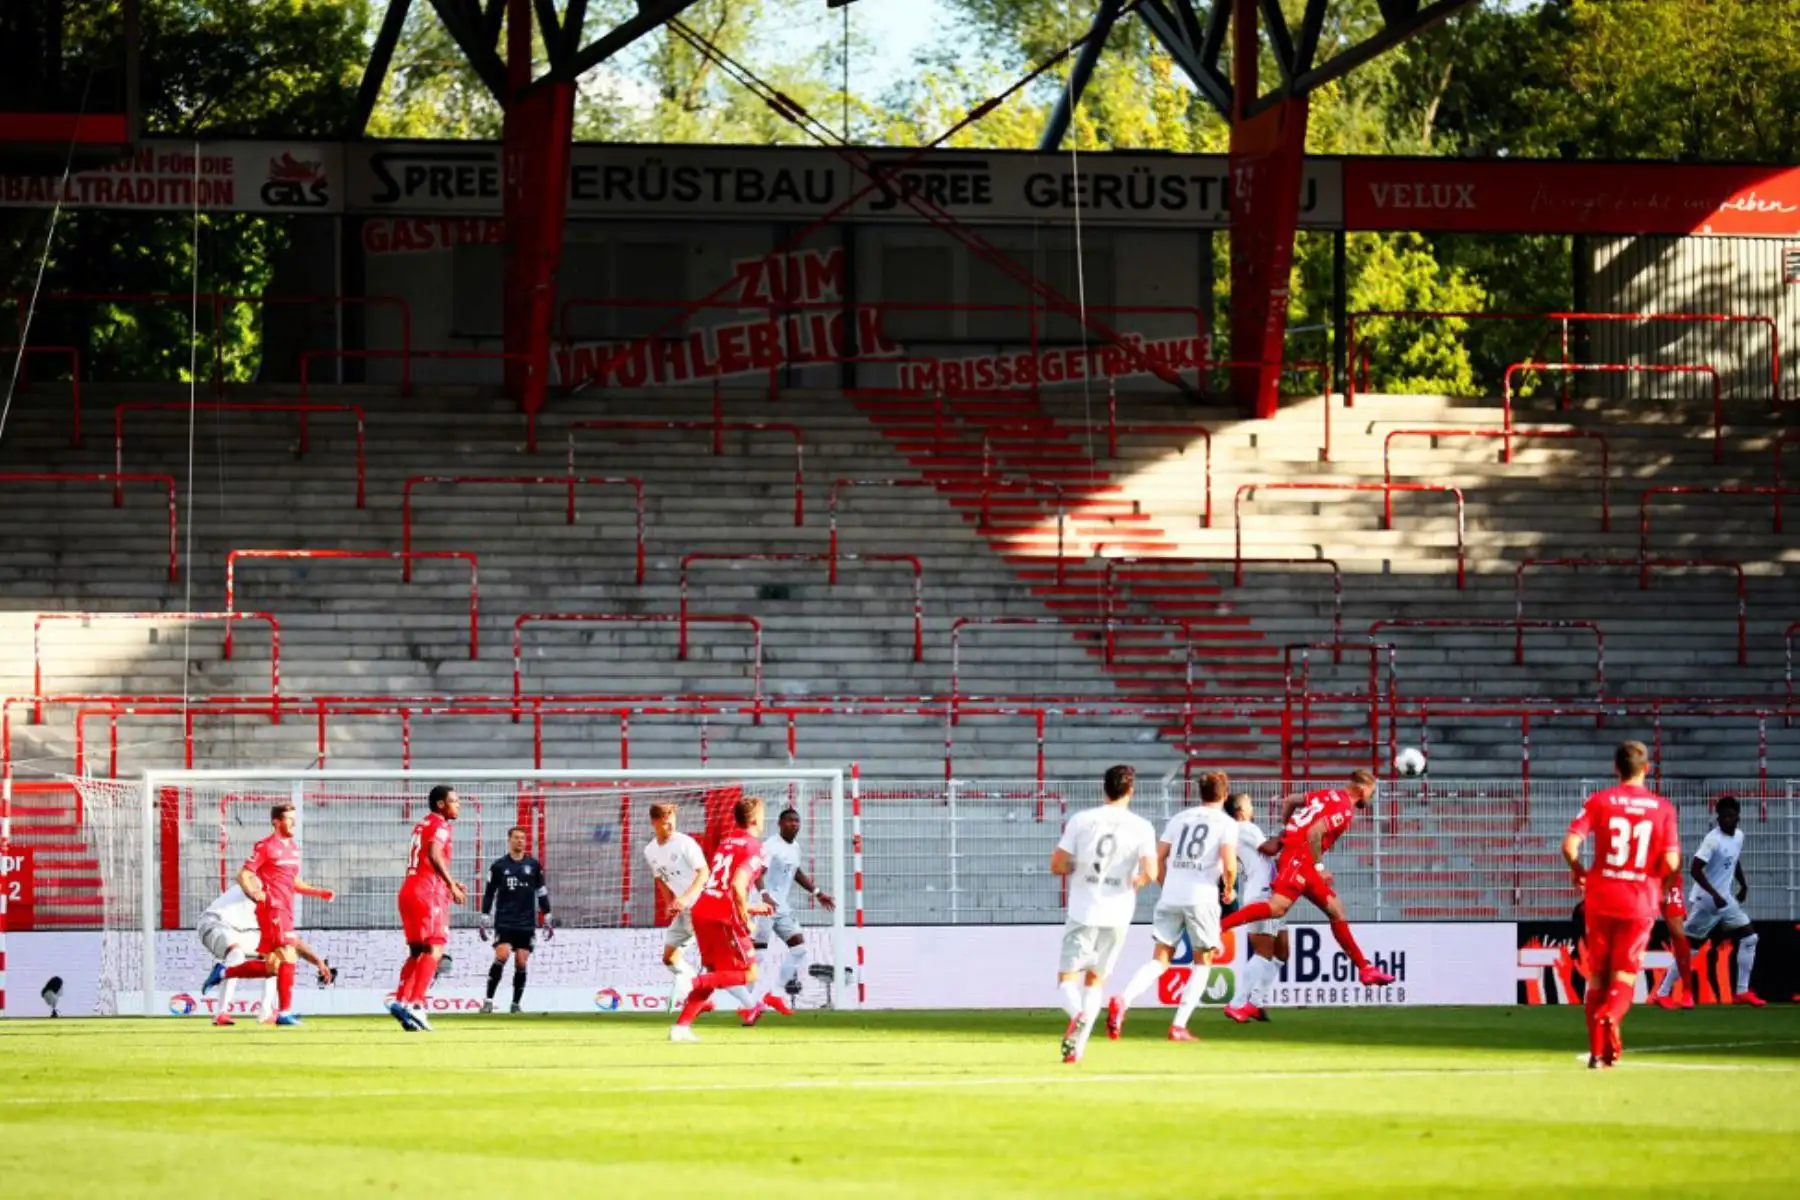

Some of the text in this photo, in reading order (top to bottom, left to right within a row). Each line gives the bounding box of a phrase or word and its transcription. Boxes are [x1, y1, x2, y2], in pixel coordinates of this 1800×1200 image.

[158, 154, 196, 174] FÜR
[202, 157, 234, 175] DIE
[370, 153, 834, 204] SPREE ERÜSTBAU
[0, 174, 234, 205] BALLTRADITION
[868, 160, 992, 209] SPREE
[1369, 182, 1477, 209] VELUX
[365, 218, 505, 253] GASTHA
[736, 250, 847, 307] ZUM
[1092, 833, 1117, 874] 9
[1176, 823, 1209, 860] 18
[1607, 816, 1653, 868] 31
[704, 853, 734, 890] 21
[1247, 986, 1406, 1004] ISTERBETRIEB
